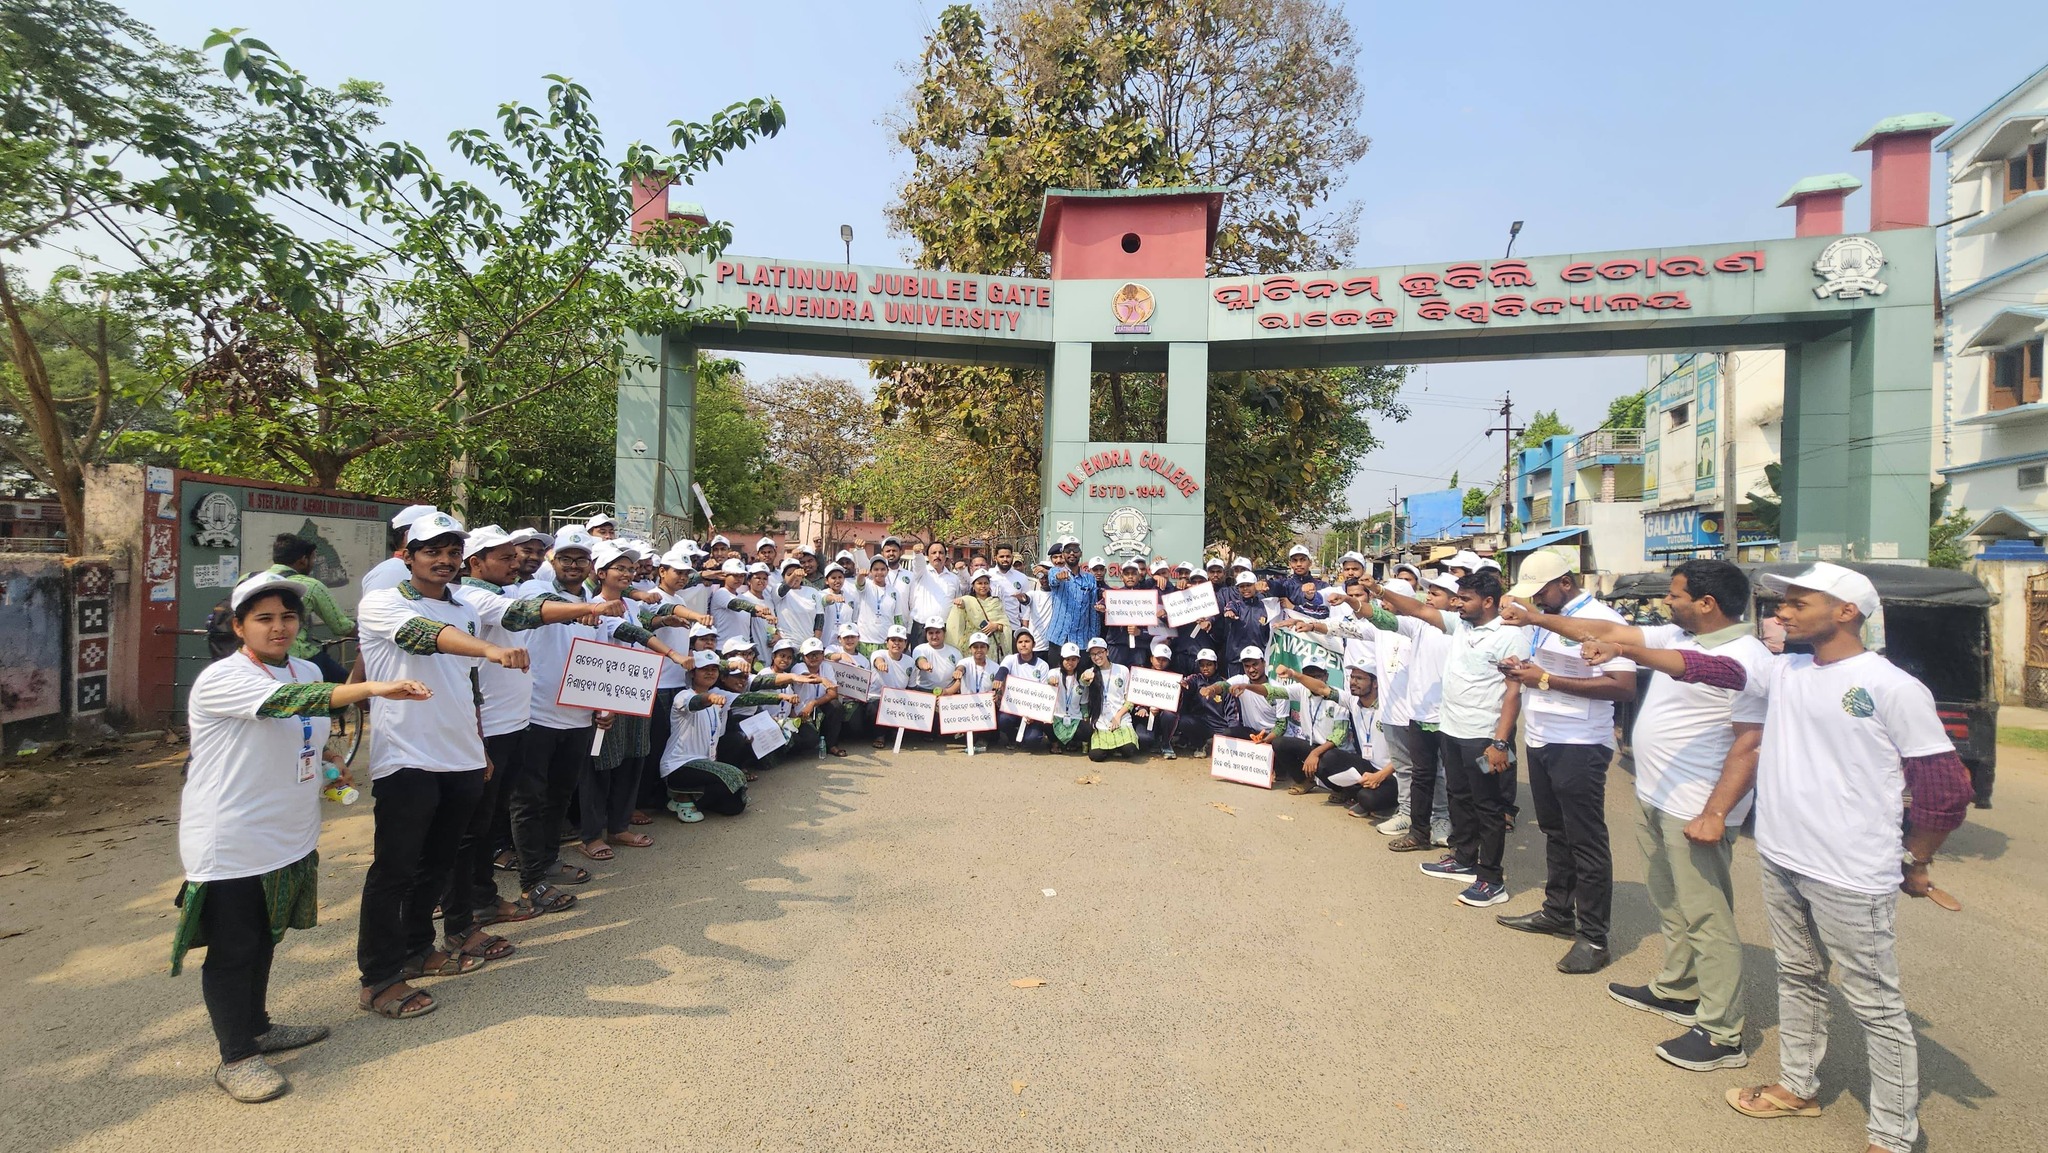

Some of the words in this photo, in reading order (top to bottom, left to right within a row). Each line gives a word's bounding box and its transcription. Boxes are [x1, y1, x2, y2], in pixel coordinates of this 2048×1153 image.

[716, 261, 857, 293] PLATINUM
[868, 273, 977, 302] JUBILEE
[987, 280, 1051, 308] GATE
[1213, 275, 1383, 311] ପ୍ଲାଟିନମ୍
[1399, 259, 1537, 297] ଜୁବିଲି
[1560, 250, 1766, 283] ତୋରଣ
[746, 291, 875, 322] RAJENDRA
[885, 302, 1021, 331] UNIVERSITY
[1257, 307, 1398, 329] ରାଜେନ୍ଦ୍ର
[1139, 450, 1200, 498] COLLEGE
[1089, 484, 1126, 498] ESTD
[1136, 485, 1166, 498] 1944
[1645, 510, 1697, 538] GALAXY
[1667, 534, 1694, 544] TUTORIAL
[576, 655, 604, 667] ସଚେତନ
